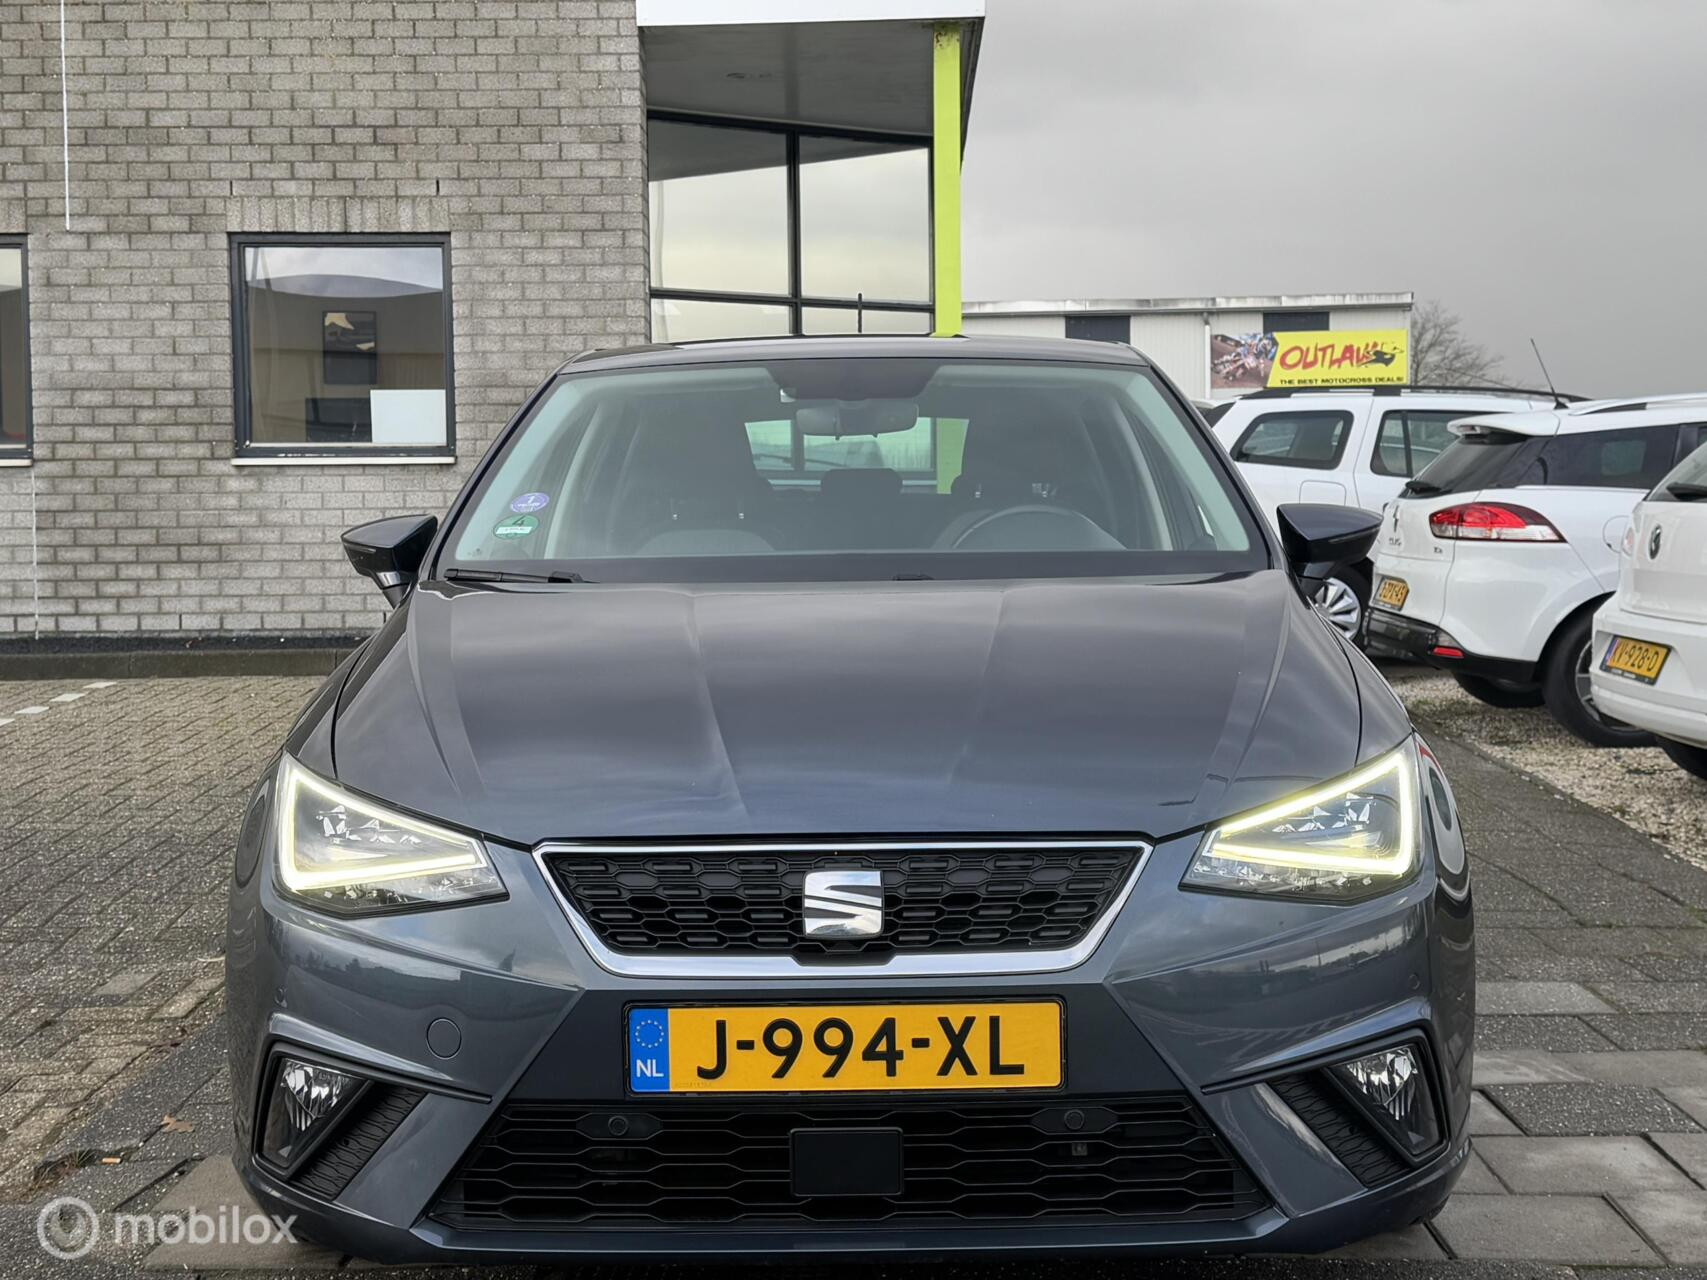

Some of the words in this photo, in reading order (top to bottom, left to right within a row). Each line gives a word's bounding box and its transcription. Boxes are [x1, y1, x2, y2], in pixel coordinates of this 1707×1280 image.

[1279, 341, 1378, 370] OUTLAW
[696, 1015, 1026, 1080] J-994-XL
[635, 1058, 664, 1078] NL
